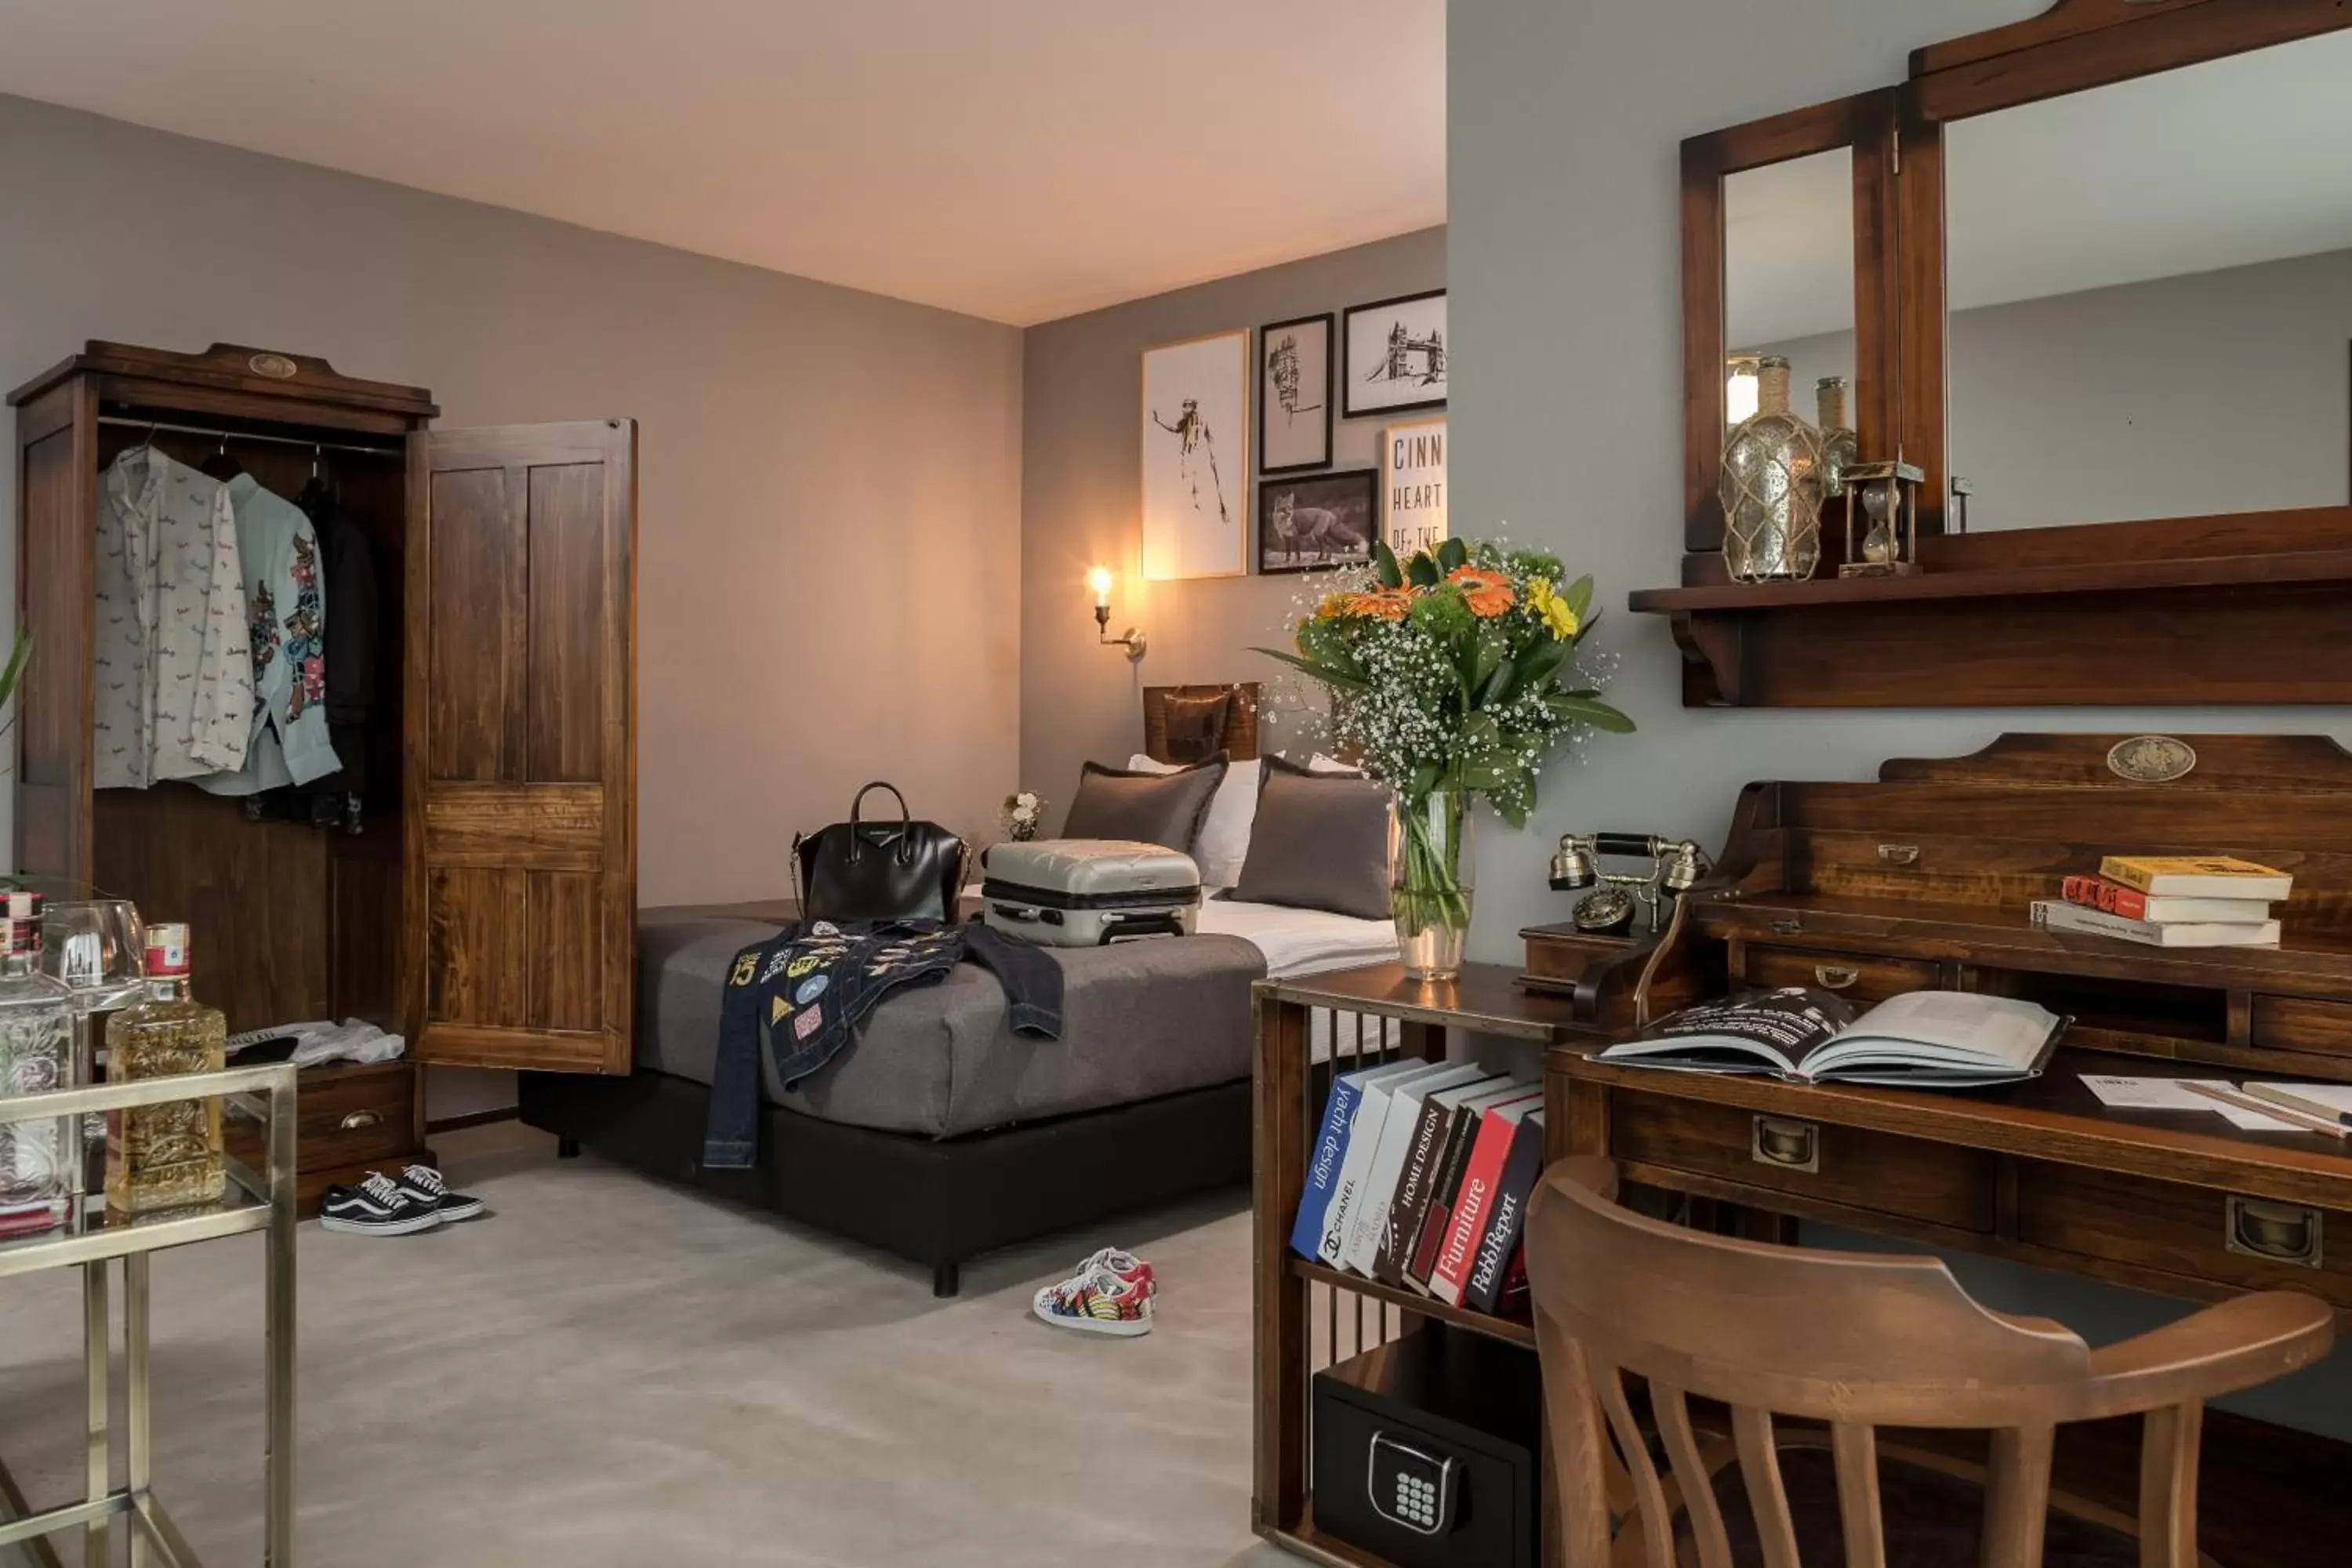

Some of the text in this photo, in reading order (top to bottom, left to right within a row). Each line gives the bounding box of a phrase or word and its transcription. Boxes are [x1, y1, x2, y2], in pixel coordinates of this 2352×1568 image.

[1394, 434, 1442, 470] CINN
[1393, 484, 1441, 511] HEART
[1393, 528, 1407, 550] OF
[1313, 1087, 1351, 1189] yacht design
[1402, 1108, 1439, 1208] HOME DESIGN
[1333, 1178, 1356, 1233] CHANEL
[1439, 1178, 1486, 1279] Furniture
[1472, 1192, 1517, 1295] Robb Report
